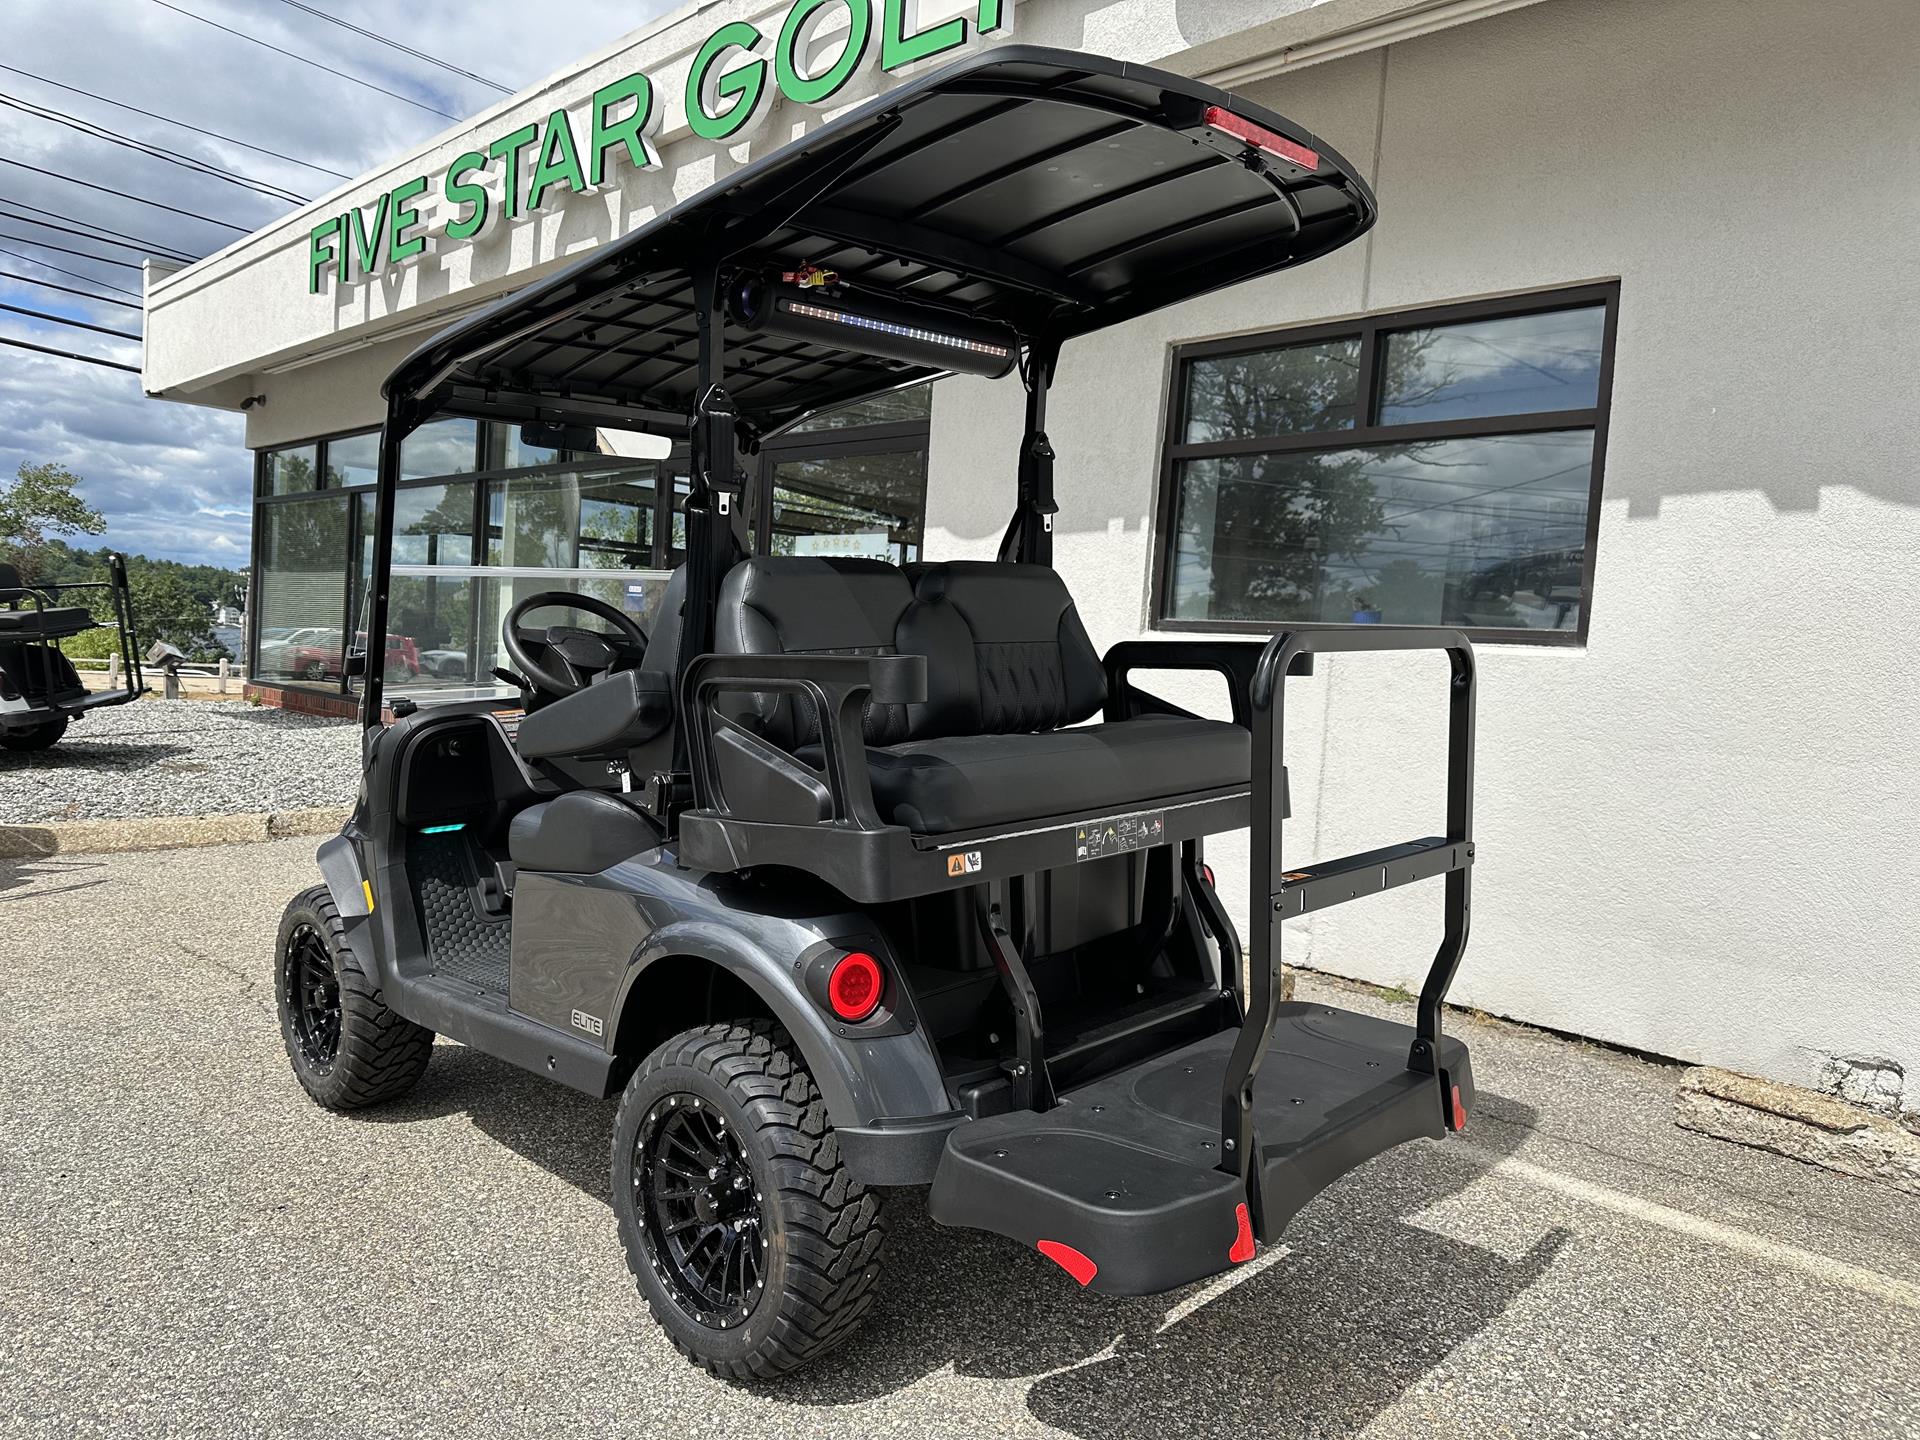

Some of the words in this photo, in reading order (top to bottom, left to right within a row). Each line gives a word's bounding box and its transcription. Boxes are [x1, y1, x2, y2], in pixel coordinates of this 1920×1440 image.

[310, 176, 427, 294] FIVE
[445, 72, 653, 239] STAR
[685, 0, 1002, 140] GOL
